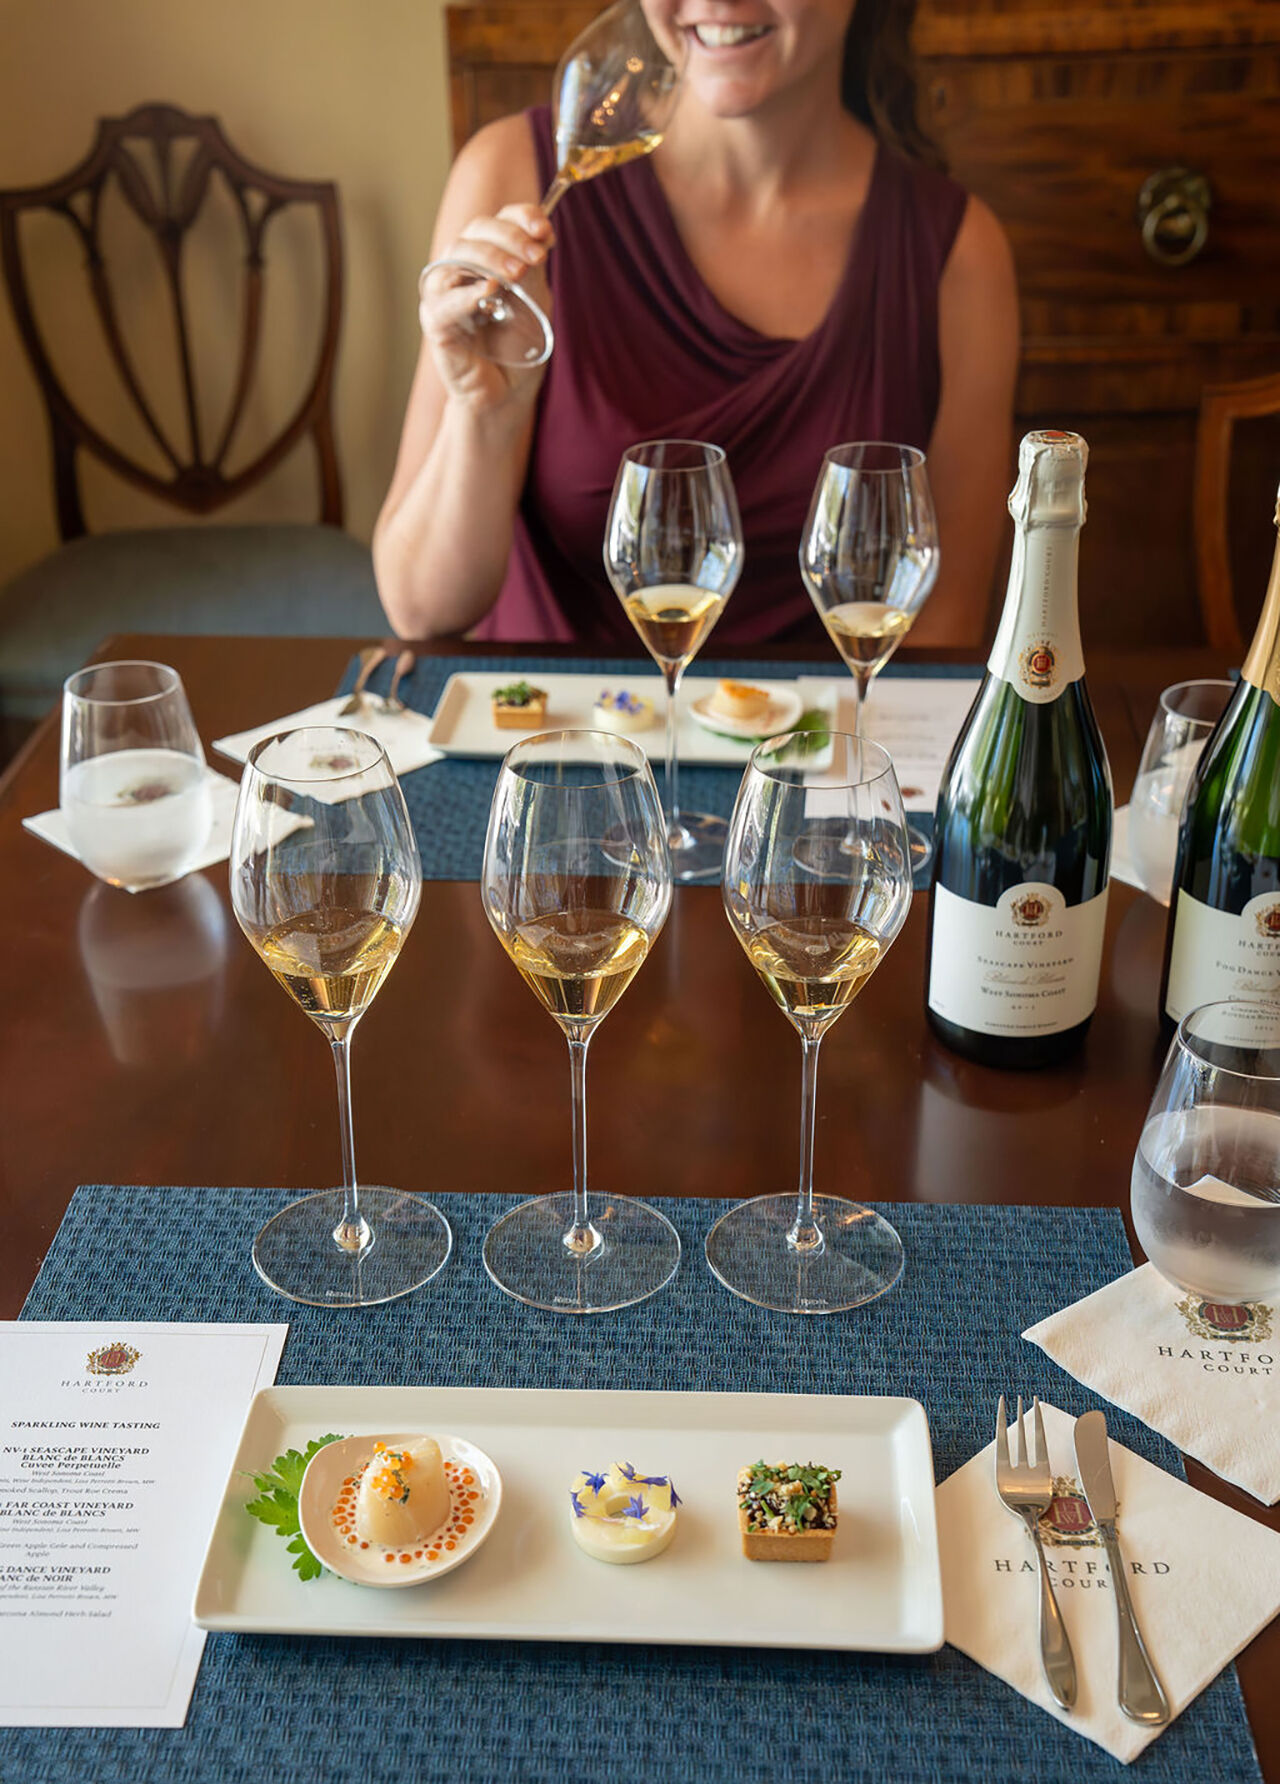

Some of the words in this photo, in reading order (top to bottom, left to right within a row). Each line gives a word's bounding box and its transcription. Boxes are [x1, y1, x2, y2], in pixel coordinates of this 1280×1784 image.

[995, 930, 1063, 940] HARTFORD
[1157, 1345, 1275, 1365] HARTFO
[1203, 1363, 1274, 1375] COURT
[61, 1379, 149, 1388] HARTFORD
[10, 1420, 77, 1430] SPARKLING
[79, 1421, 110, 1430] WINE
[112, 1422, 161, 1430] TASTING
[29, 1446, 88, 1455] SEASCAPE
[91, 1447, 150, 1455] VINEYARD
[22, 1454, 62, 1462] BLANC
[80, 1454, 126, 1462] BLANCS
[57, 1461, 122, 1470] Perpetuelle
[5, 1501, 29, 1509] FAR
[31, 1501, 71, 1509] COAST
[73, 1502, 135, 1510] VINEYARD
[0, 1509, 41, 1517] BLANC
[42, 1509, 57, 1517] de
[60, 1510, 107, 1518] BLANCS
[6, 1565, 48, 1574] DANCE
[51, 1566, 112, 1575] VINEYARD
[25, 1574, 41, 1582] de
[43, 1574, 74, 1582] NOIR
[1050, 1577, 1109, 1590] COUR
